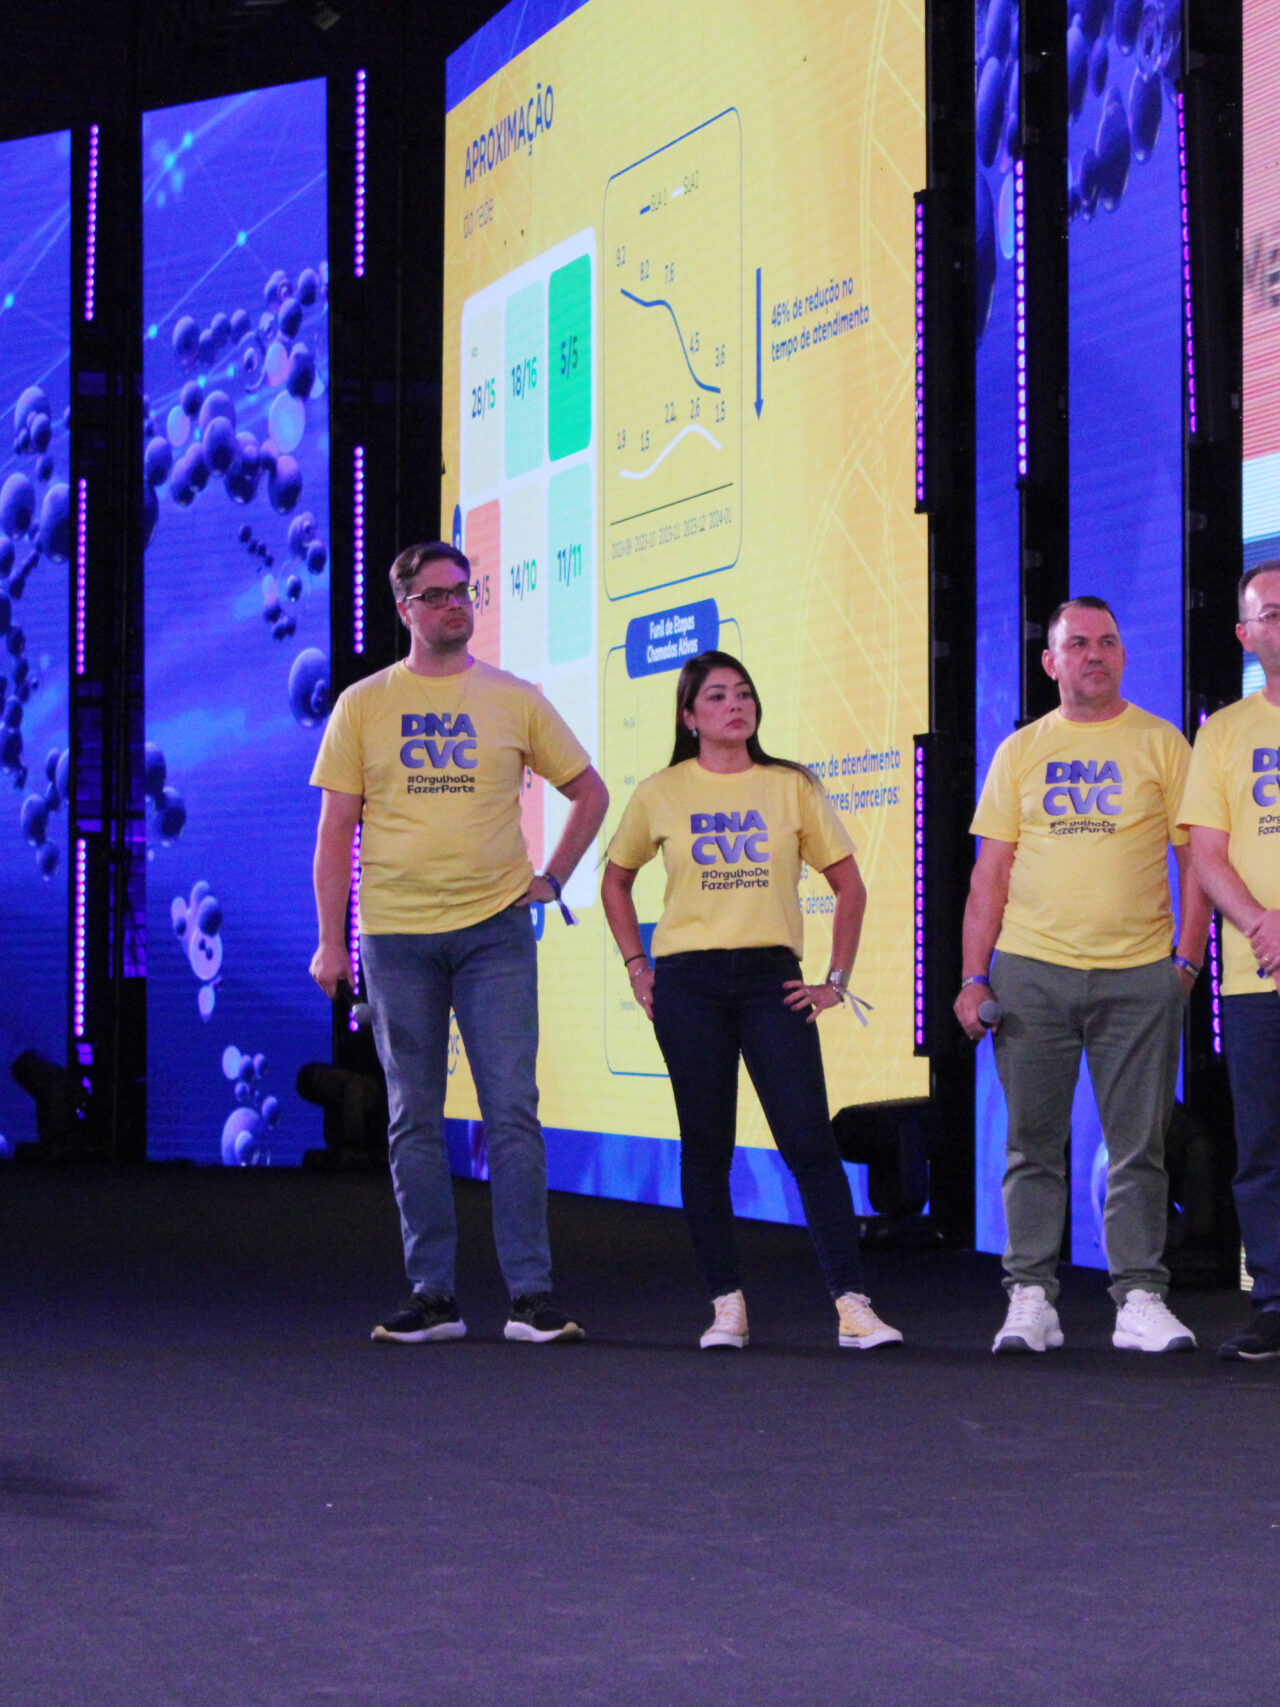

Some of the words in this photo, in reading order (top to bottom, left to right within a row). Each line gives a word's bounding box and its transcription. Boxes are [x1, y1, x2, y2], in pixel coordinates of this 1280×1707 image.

[463, 82, 554, 189] APROXIMAÇÃO
[771, 300, 791, 328] 46%
[792, 296, 803, 320] de
[805, 278, 840, 315] redução
[842, 277, 854, 299] no
[771, 341, 799, 362] tempo
[800, 327, 811, 350] de
[813, 303, 870, 345] atendimento
[560, 335, 579, 379] 5/5
[511, 355, 538, 401] 18/16
[471, 377, 496, 421] 28/15
[510, 558, 538, 602] 14/10
[557, 543, 583, 588] 11/11
[649, 618, 665, 640] Funil
[665, 617, 674, 637] de
[673, 615, 696, 636] Etapas
[646, 640, 678, 664] Chamados
[678, 637, 699, 656] Ativos
[401, 712, 477, 738] DNA
[400, 739, 478, 770] CVC
[828, 753, 840, 779] de
[841, 745, 901, 776] atendimento
[408, 774, 475, 786] #OrgulhoDe
[1045, 759, 1123, 785] DNA
[407, 784, 475, 794] FazerParte
[1043, 785, 1123, 816] CVC
[690, 809, 768, 834] DNA
[691, 832, 770, 866] CVC
[701, 867, 769, 881] #OrgulhoDe
[701, 878, 769, 891] FazerParte
